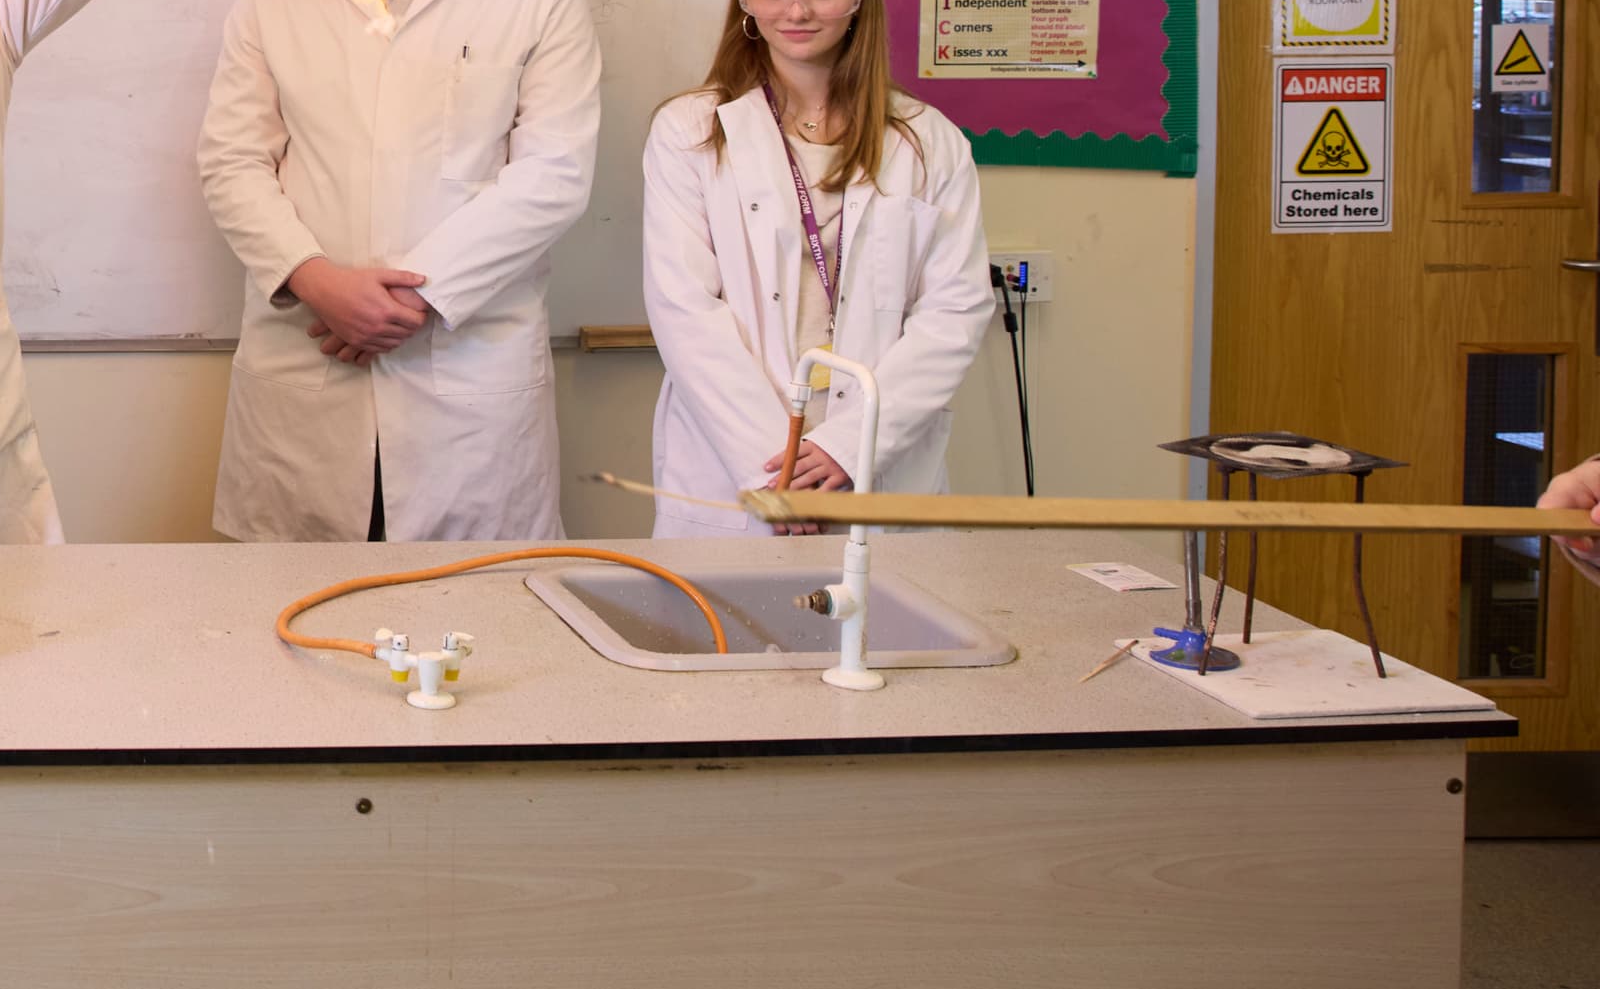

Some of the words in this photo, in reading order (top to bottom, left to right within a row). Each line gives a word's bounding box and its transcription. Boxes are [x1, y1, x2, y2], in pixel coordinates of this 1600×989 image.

[938, 20, 951, 35] C
[953, 24, 993, 33] orners
[938, 45, 950, 60] K
[952, 46, 982, 57] isses
[986, 48, 1008, 57] xxx
[1304, 75, 1381, 95] DANGER
[799, 189, 812, 215] FORM
[1291, 188, 1374, 201] Chemicals
[1286, 205, 1339, 218] Stored
[1343, 204, 1379, 216] here
[809, 233, 822, 261] SIXTH
[816, 260, 829, 287] FORM
